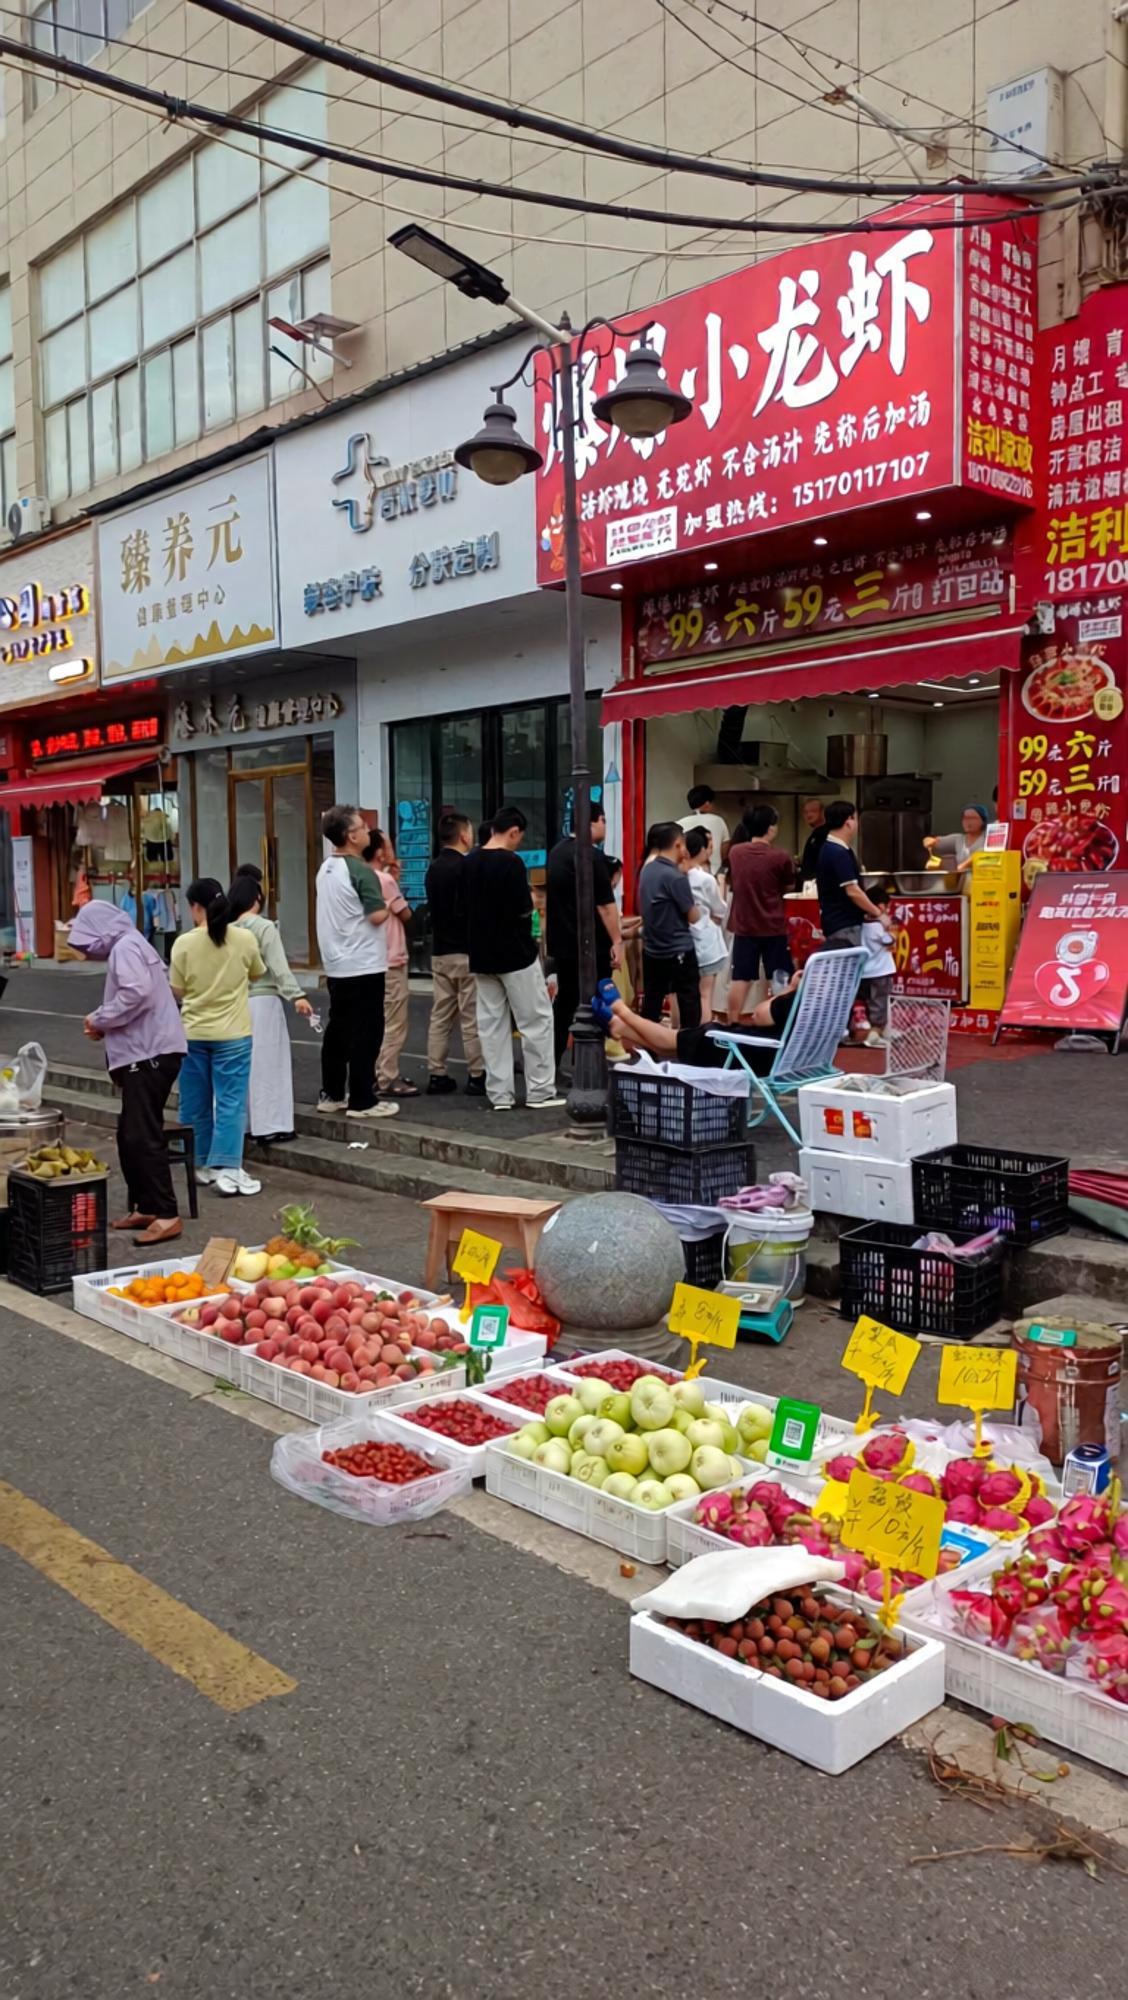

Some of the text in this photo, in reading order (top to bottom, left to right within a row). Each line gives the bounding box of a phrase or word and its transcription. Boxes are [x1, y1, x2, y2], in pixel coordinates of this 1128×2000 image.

[813, 390, 932, 456] 先称后加汤
[1050, 399, 1123, 442] 房屋出租
[792, 451, 931, 507] 15170117107
[1018, 730, 1113, 764] 99元六斤
